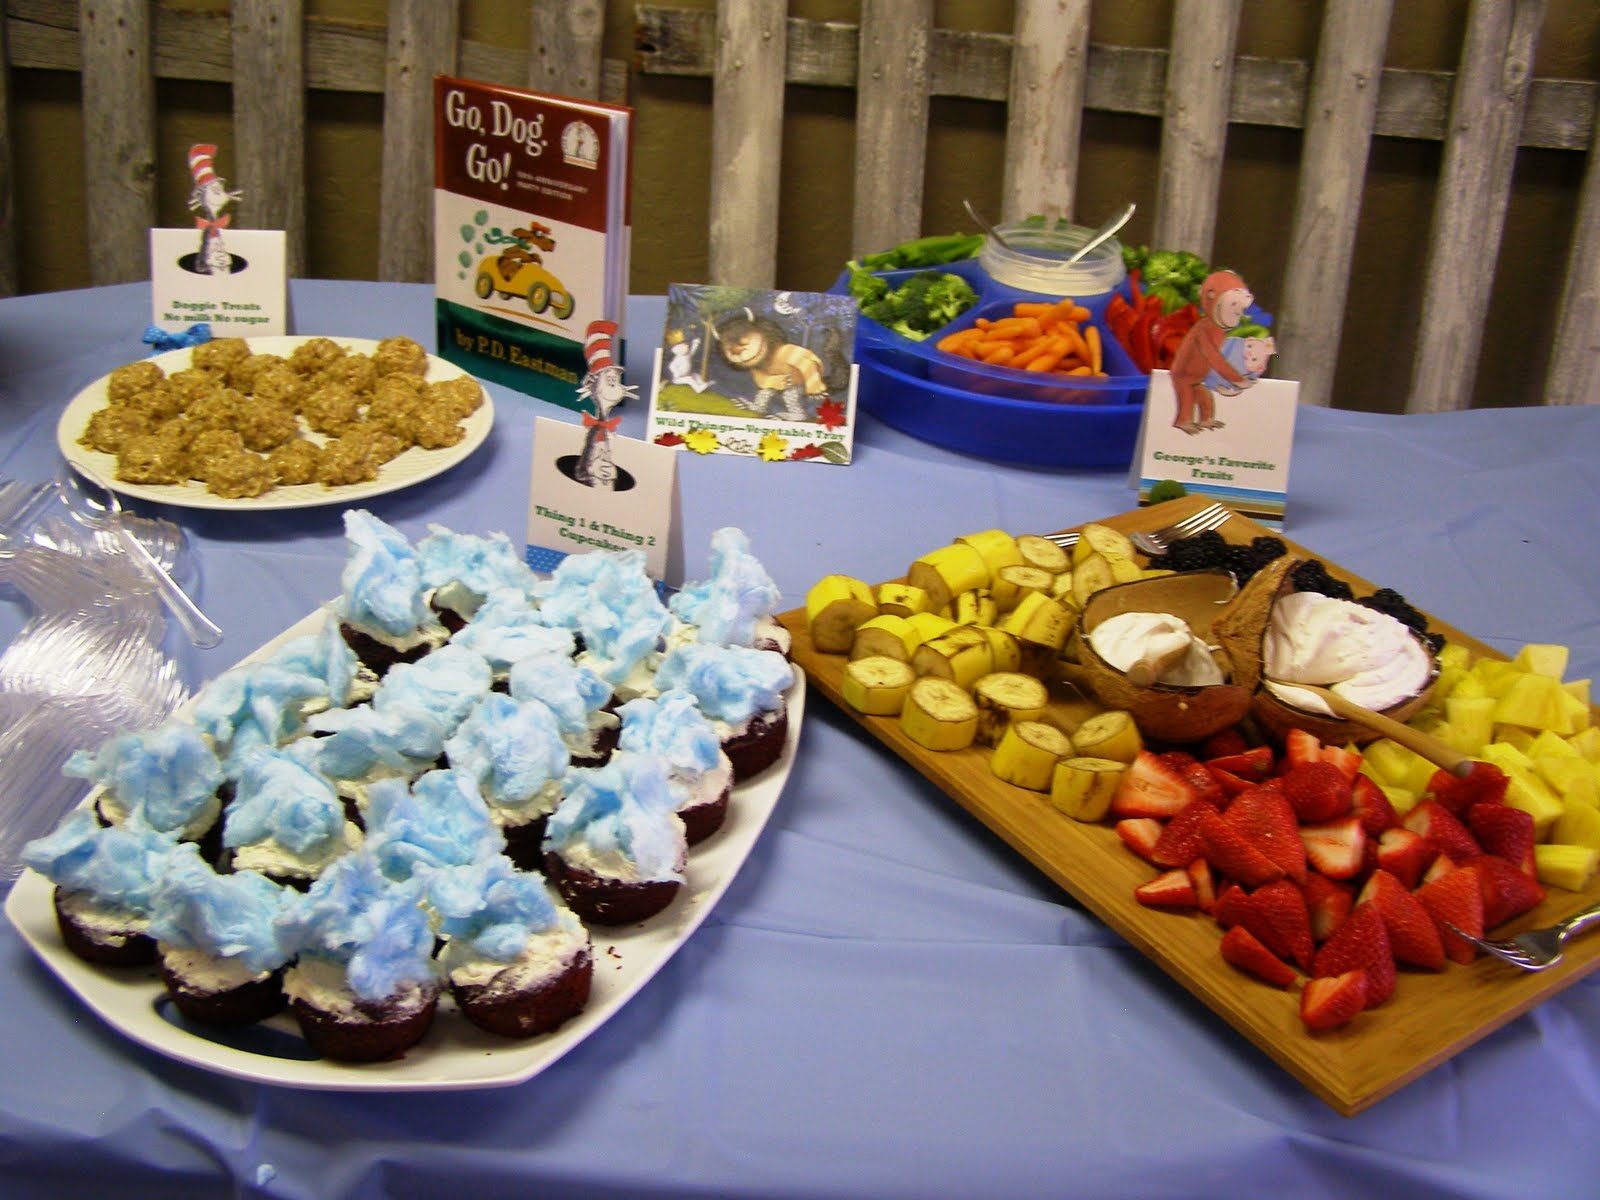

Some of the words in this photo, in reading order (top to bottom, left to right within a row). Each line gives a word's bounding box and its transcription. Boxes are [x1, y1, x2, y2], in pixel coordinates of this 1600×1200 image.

[446, 90, 485, 136] Go,
[490, 101, 549, 156] Dog.
[466, 143, 512, 190] Go!
[172, 300, 217, 311] Doggie
[221, 301, 261, 311] Treats
[163, 312, 181, 321] No
[183, 313, 211, 322] milk
[213, 314, 231, 322] No
[233, 316, 270, 325] sugar
[455, 328, 473, 352] by
[510, 345, 579, 385] Eastman
[655, 417, 685, 427] Wild
[816, 430, 846, 440] Tray
[1153, 451, 1216, 466] George's
[1218, 456, 1276, 471] Favorite
[1192, 468, 1235, 481] Fruits
[535, 505, 576, 527] Thing
[579, 518, 586, 527] 1
[590, 522, 600, 531] &
[602, 524, 645, 545] Thing
[647, 536, 656, 546] 2
